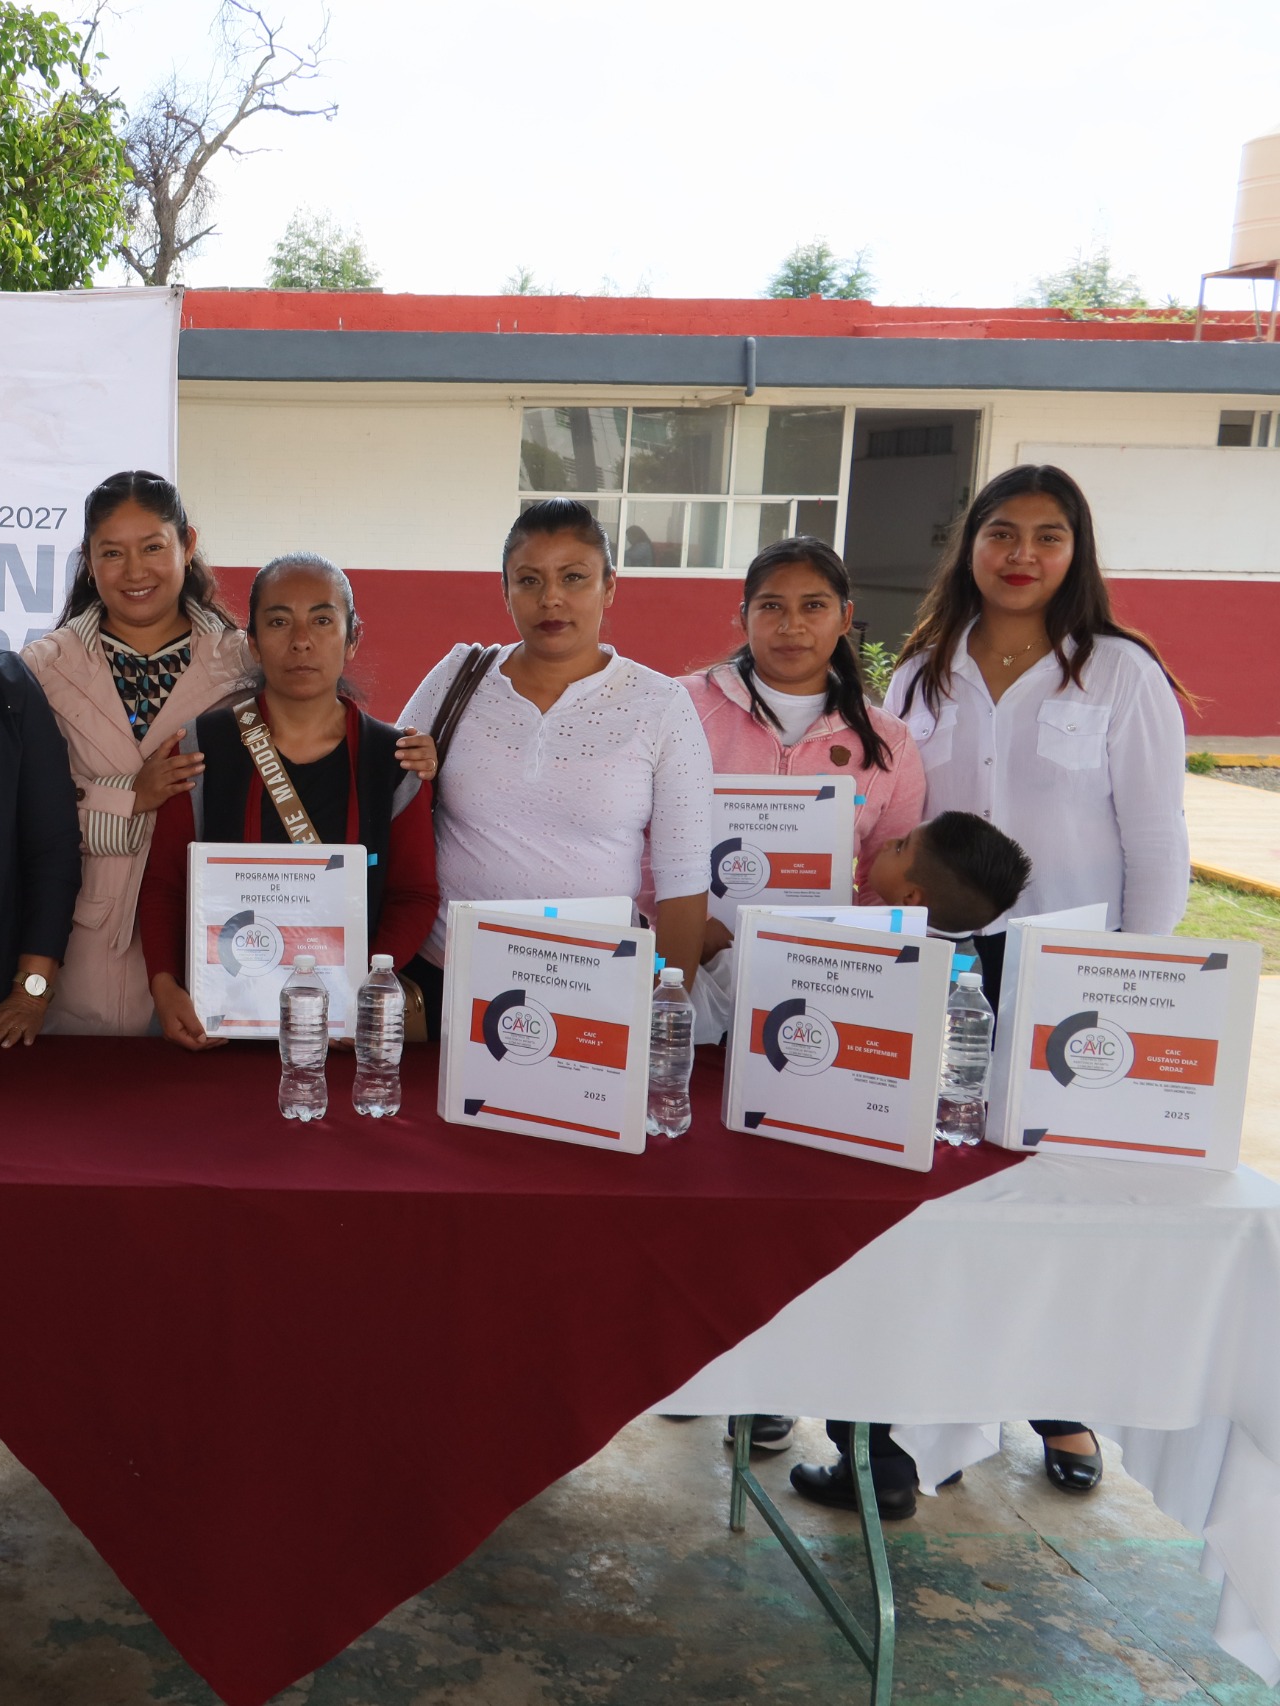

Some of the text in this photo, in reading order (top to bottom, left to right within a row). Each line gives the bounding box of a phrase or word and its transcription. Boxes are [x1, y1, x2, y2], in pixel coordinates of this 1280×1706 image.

[246, 727, 293, 804] MADDEN
[724, 802, 768, 810] PROGRAMA
[285, 810, 315, 844] EVE
[729, 822, 778, 830] PROTECCIÓN
[722, 861, 756, 872] CAIC
[235, 872, 279, 880] PROGRAMA
[241, 894, 289, 902] PROTECCIÓN
[235, 935, 270, 947] CAIC
[508, 944, 600, 966] PROGRAMA INTERNO
[546, 964, 558, 972] DE
[787, 952, 882, 973] PROGRAMA INTERNO
[827, 971, 839, 980] DE
[1077, 965, 1186, 982] PROGRAMA INTERNO
[512, 971, 591, 991] PROTECCIÓN CIVIL
[1123, 982, 1137, 991] DE
[791, 979, 874, 998] PROTECCIÓN CIVIL
[1082, 992, 1176, 1007] PROTECCIÓN CIVIL
[502, 1016, 540, 1035] CAIC
[782, 1025, 822, 1044] CAIC
[863, 1047, 898, 1058] SEPTIEMBRE
[1070, 1039, 1115, 1056] CAIC
[1147, 1056, 1198, 1067] GUSTAVO DIAZ
[1159, 1065, 1184, 1073] ORDAZ
[584, 1091, 606, 1102] 2025
[866, 1102, 890, 1113] 2025
[1164, 1110, 1190, 1120] 2025
